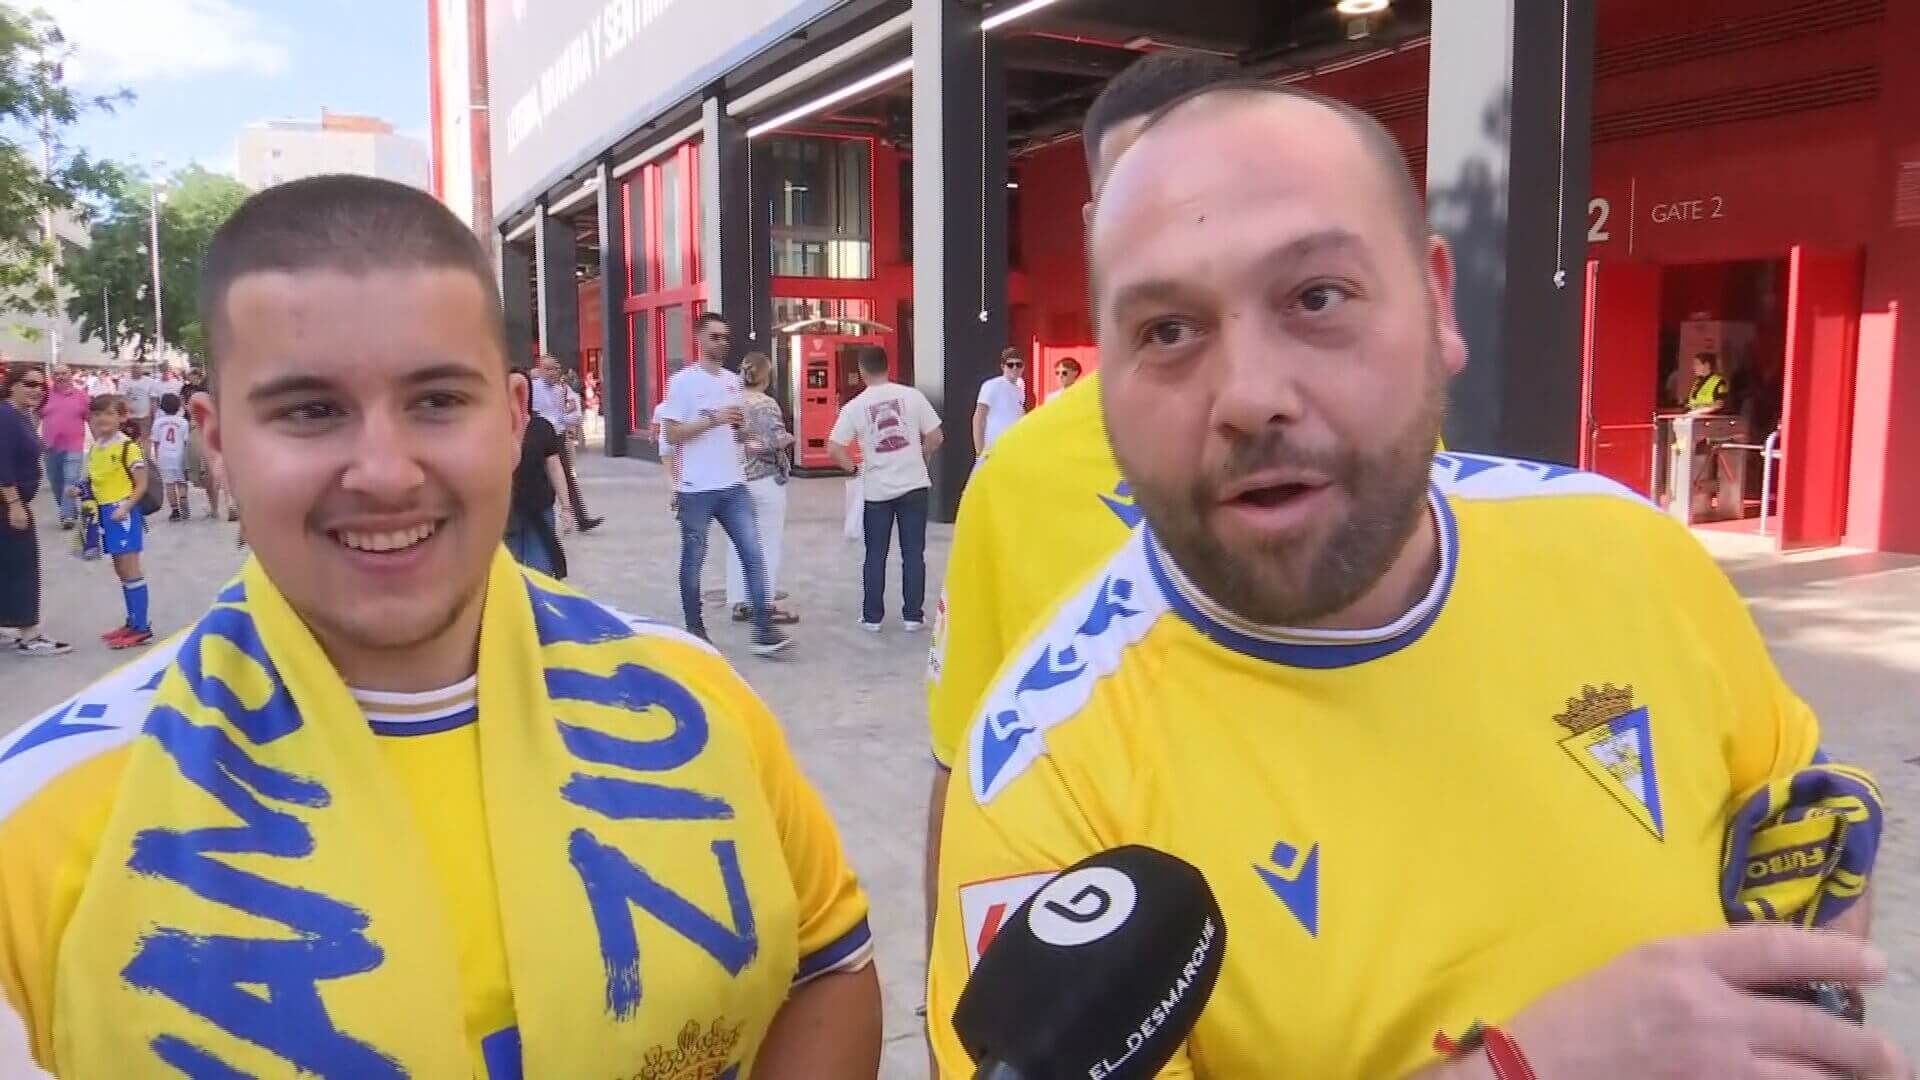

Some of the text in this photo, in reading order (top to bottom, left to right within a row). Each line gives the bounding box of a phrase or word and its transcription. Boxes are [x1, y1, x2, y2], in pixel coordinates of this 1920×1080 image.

[1587, 197, 1610, 242] 2
[1651, 195, 1726, 224] GATE 2
